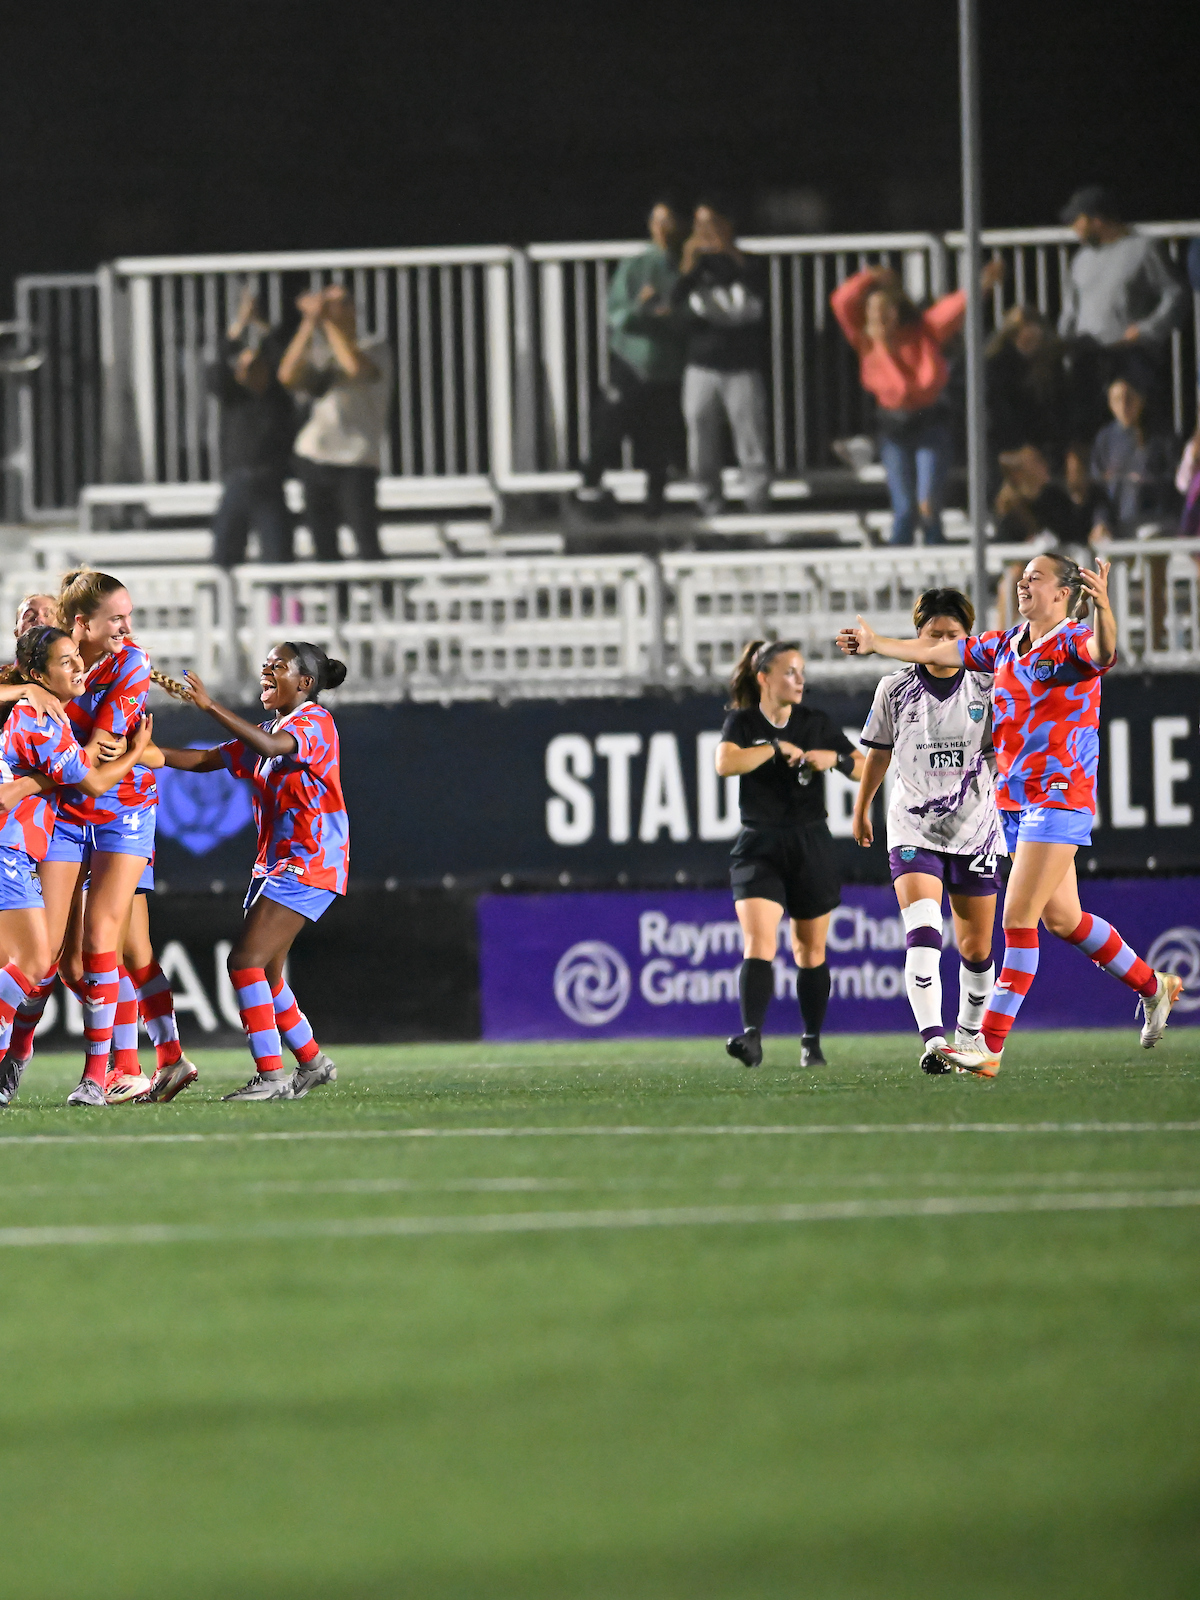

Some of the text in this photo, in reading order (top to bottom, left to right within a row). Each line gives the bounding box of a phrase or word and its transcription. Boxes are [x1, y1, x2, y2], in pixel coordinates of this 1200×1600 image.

[916, 739, 972, 750] WOMEN'S HEAL
[544, 728, 742, 845] STAD
[122, 811, 141, 831] 4
[968, 853, 998, 874] 24
[639, 957, 741, 1006] Gran
